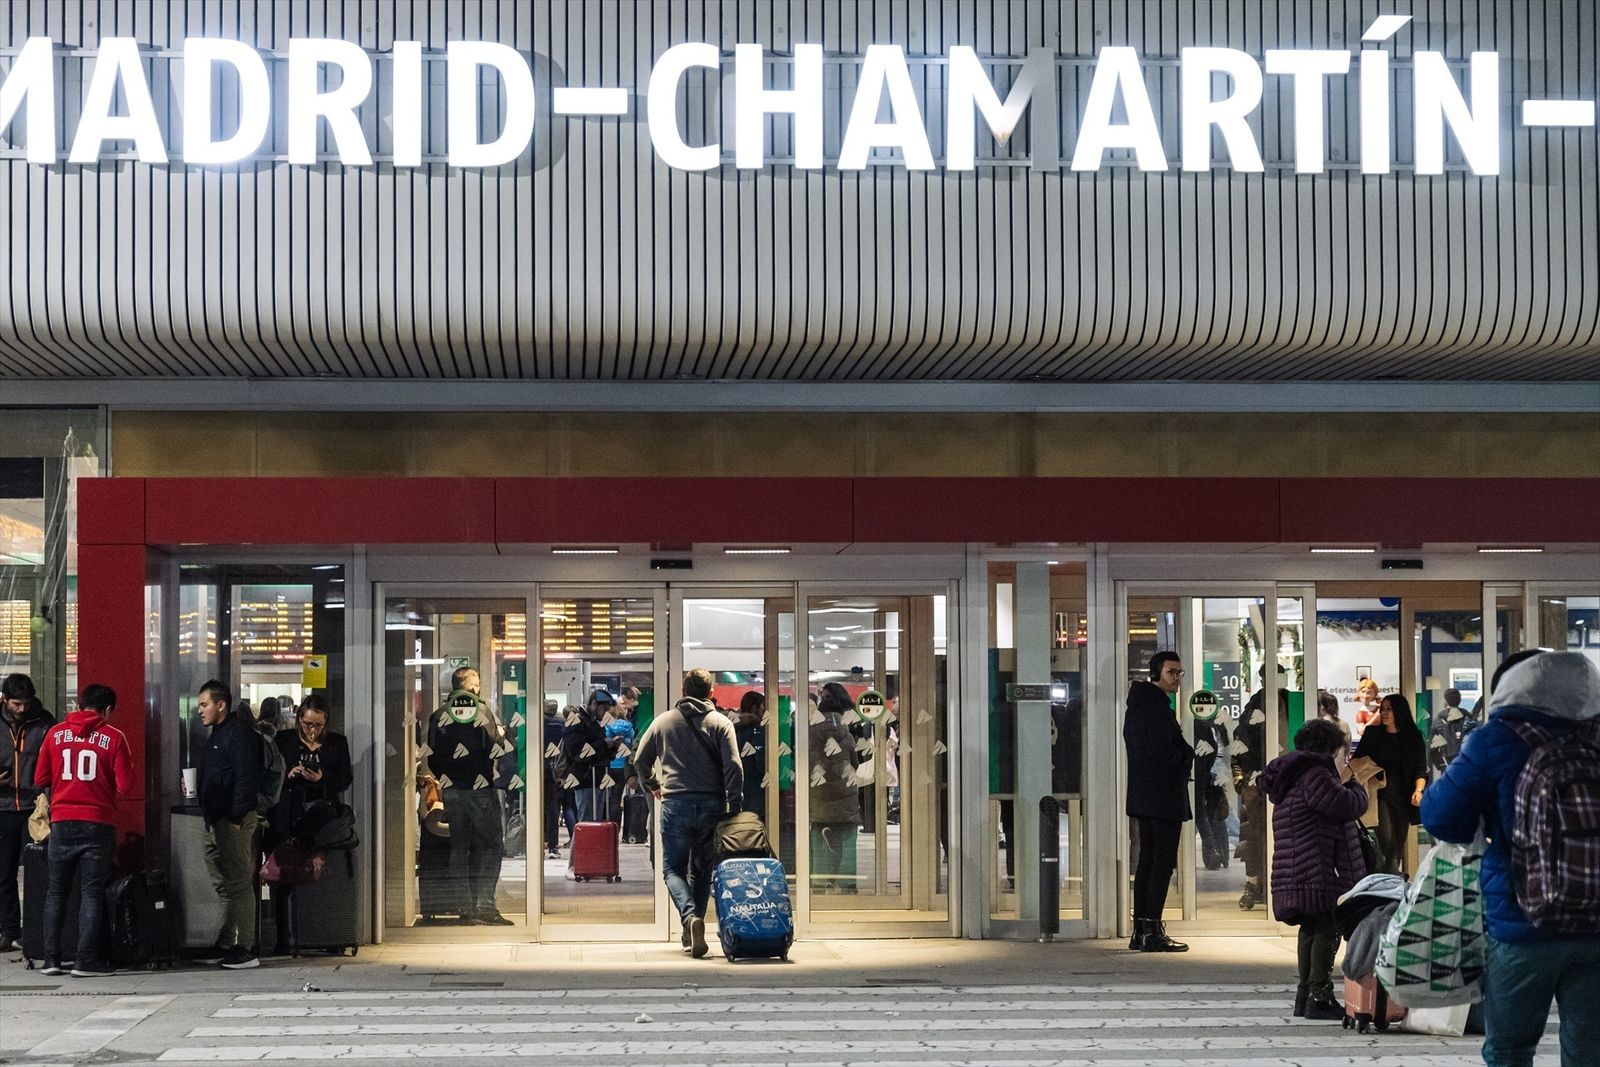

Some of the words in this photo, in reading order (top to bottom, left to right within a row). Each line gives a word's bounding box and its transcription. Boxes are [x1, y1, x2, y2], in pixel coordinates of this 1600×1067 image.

[1222, 675, 1239, 689] 10
[62, 748, 97, 781] 10
[730, 902, 777, 913] NAUTALIA
